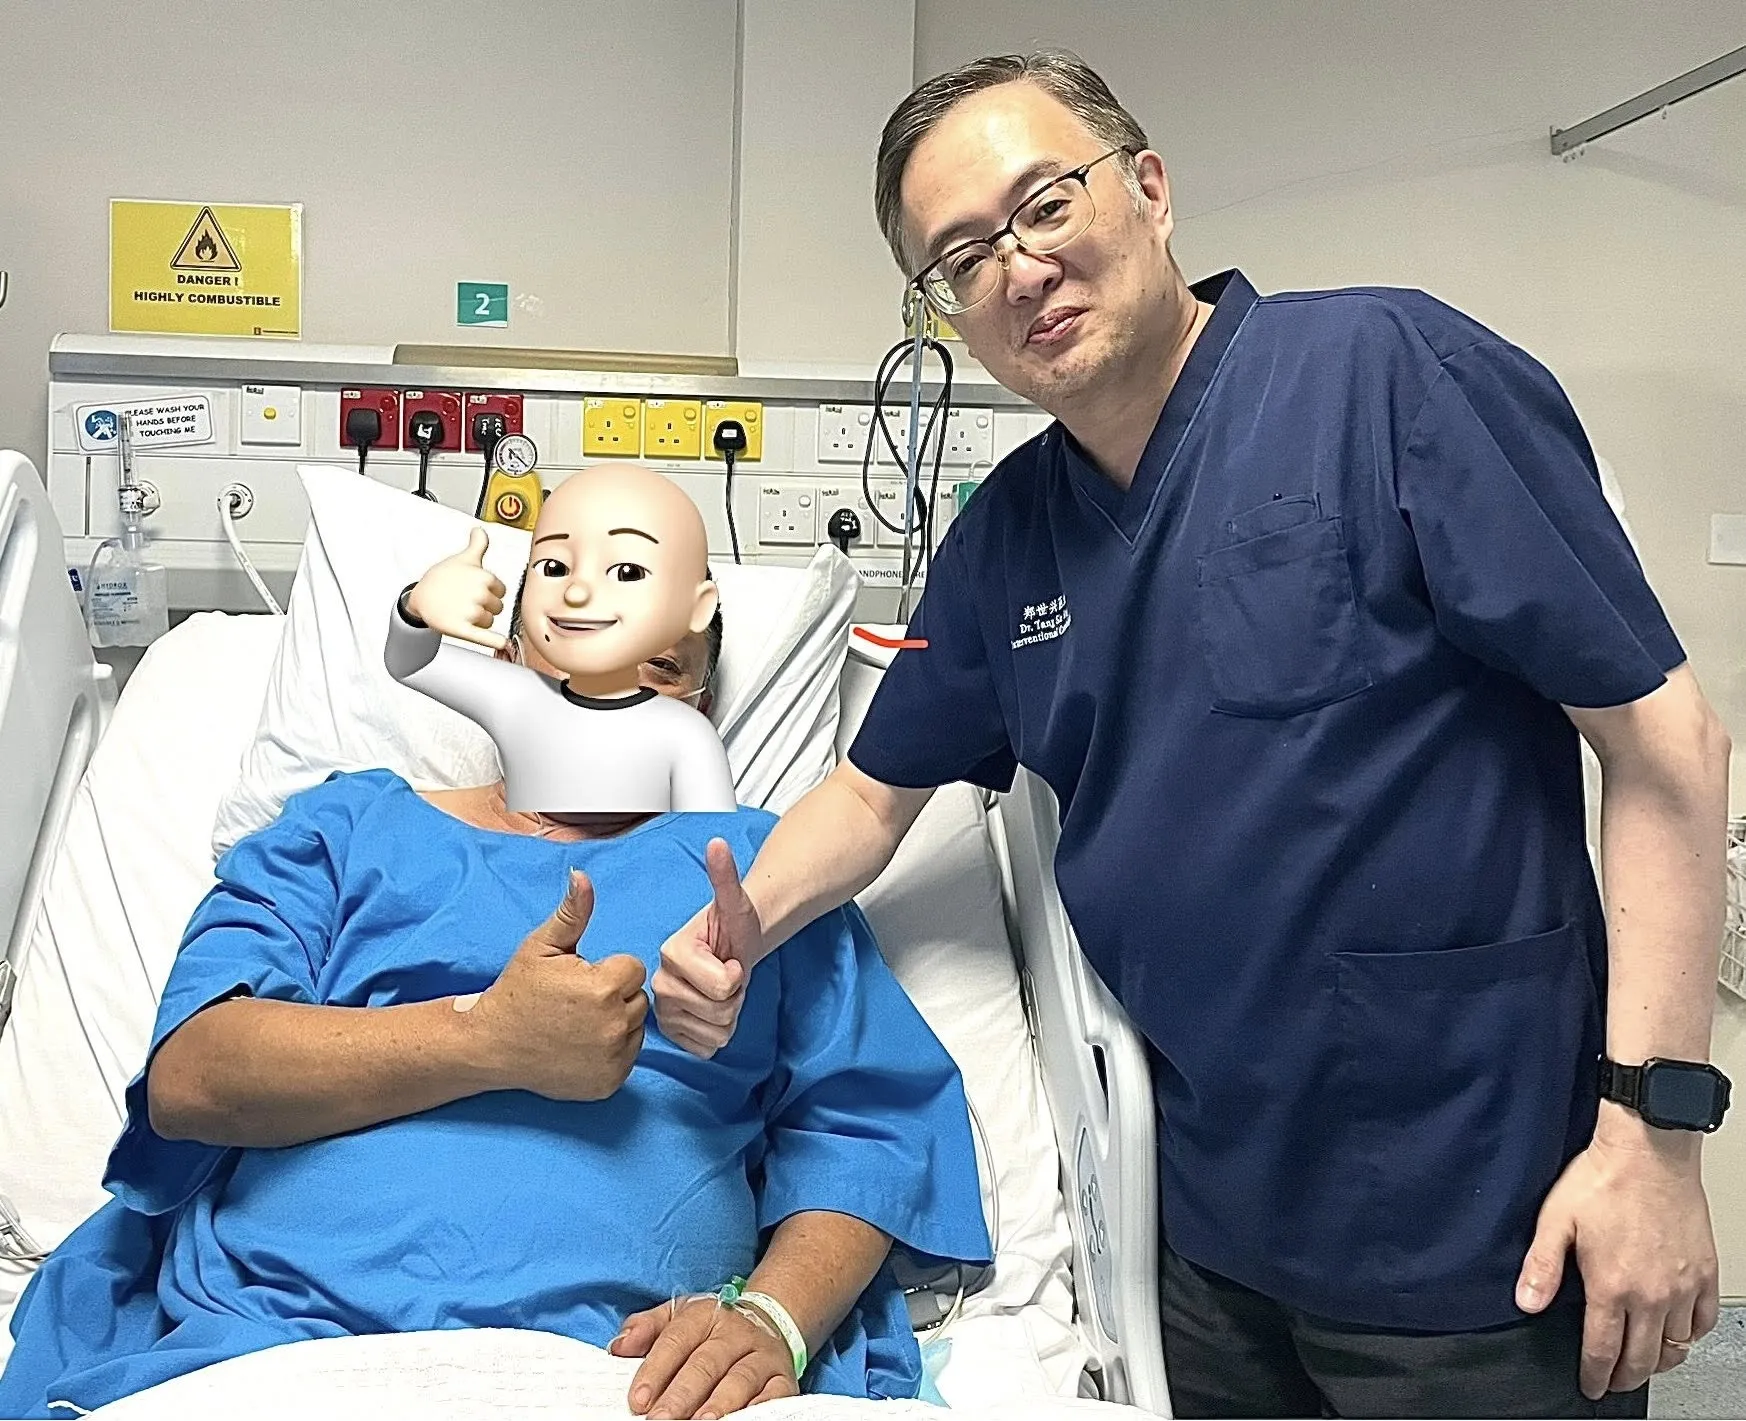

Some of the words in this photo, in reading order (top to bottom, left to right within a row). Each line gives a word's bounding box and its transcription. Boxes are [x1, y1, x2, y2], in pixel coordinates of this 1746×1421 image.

[177, 274, 231, 286] DANGER
[134, 291, 184, 303] HIGHLY
[188, 293, 281, 306] COMBUSTIBLE
[474, 293, 490, 315] 2
[156, 405, 181, 415] WASH
[183, 403, 205, 413] YOUR
[136, 416, 164, 427] HANDS
[166, 414, 196, 425] BEFORE
[139, 427, 182, 438] TOUCHING
[184, 425, 196, 435] ME
[1019, 623, 1034, 634] Dr.
